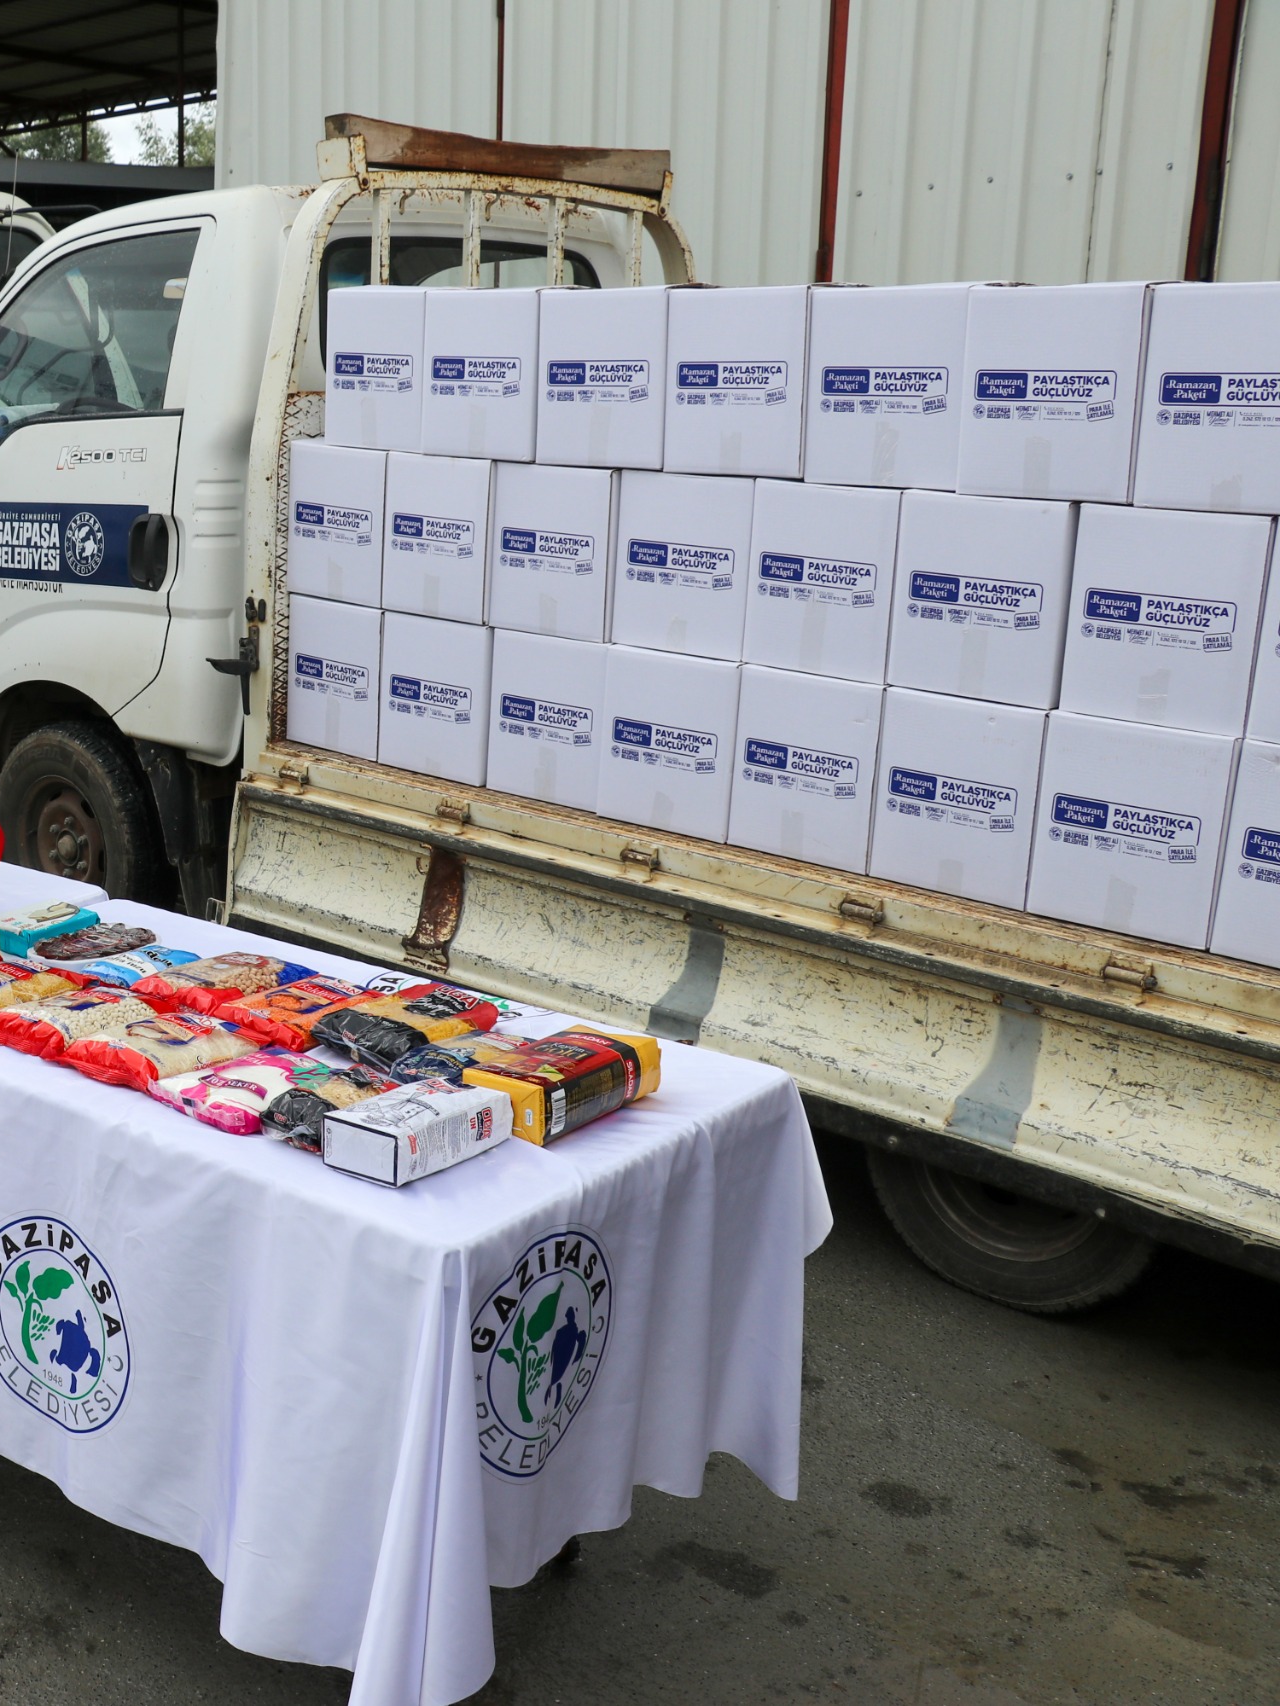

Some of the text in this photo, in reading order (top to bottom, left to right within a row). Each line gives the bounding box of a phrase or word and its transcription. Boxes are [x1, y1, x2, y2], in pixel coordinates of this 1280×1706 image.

[366, 357, 408, 366] PAYLAŞTIKÇA
[467, 360, 516, 370] PAYLAŞTIKÇA
[366, 364, 400, 375] GÜÇLÜYÜZ
[467, 368, 505, 379] GÜÇLÜYÜZ
[588, 364, 643, 374] PAYLAŞTIKÇA
[680, 367, 717, 377] Ramazan
[723, 365, 783, 376] PAYLAŞTIKÇA
[588, 372, 632, 384] GÜÇLÜYÜZ
[686, 375, 709, 385] Paketi
[722, 374, 770, 386] GÜÇLÜYÜZ
[826, 372, 867, 384] Ramazan
[874, 371, 942, 382] PAYLAŞTIKÇA
[980, 375, 1025, 388] Ramazan
[1033, 375, 1109, 387] PAYLAŞTIKÇA
[832, 381, 858, 391] Paketi
[873, 380, 928, 394] GÜÇLÜYÜZ
[986, 385, 1015, 396] Paketi
[1032, 384, 1093, 399] GÜÇLÜYÜZ
[1166, 379, 1218, 392] Ramazan
[1173, 389, 1206, 401] Paketi
[56, 445, 147, 470] K2500 TCI
[326, 508, 368, 521] PAYLAŞTIKÇA
[326, 515, 359, 528] GÜÇLÜYÜZ
[425, 519, 469, 532] PAYLAŞTIKÇA
[425, 527, 460, 540] GÜÇLÜYÜZ
[539, 534, 589, 548] PAYLAŞTIKÇA
[538, 542, 578, 556] GÜÇLÜYÜZ
[631, 544, 665, 557] Ramazan
[671, 547, 729, 562] PAYLAŞTIKÇA
[636, 553, 658, 563] Paketi
[671, 555, 716, 570] GÜÇLÜYÜZ
[763, 557, 802, 572] Ramazan
[769, 566, 793, 578] Paketi
[808, 561, 871, 578] PAYLAŞTIKÇA
[807, 570, 858, 587] GÜÇLÜYÜZ
[914, 576, 957, 592] Ramazan
[920, 587, 947, 598] Paketi
[964, 581, 1036, 598] PAYLAŞTIKÇA
[963, 591, 1021, 608] GÜÇLÜYÜZ
[1090, 594, 1138, 611] Ramazan
[1096, 605, 1127, 617] Paketi
[1147, 599, 1229, 618] PAYLAŞTIKÇA
[1145, 609, 1211, 628] GÜÇLÜYÜZ
[324, 662, 363, 678] PAYLAŞTIKÇA
[324, 670, 355, 685] GÜÇLÜYÜZ
[424, 684, 468, 700] PAYLAŞTIKÇA
[423, 692, 458, 707] GÜÇLÜYÜZ
[538, 703, 587, 720] PAYLAŞTIKÇA
[537, 712, 577, 727] GÜÇLÜYÜZ
[616, 722, 649, 738] Ramazan
[621, 731, 642, 742] Paketi
[655, 728, 711, 746] PAYLAŞTIKÇA
[654, 737, 699, 754] GÜÇLÜYÜZ
[749, 743, 785, 760] Ramazan
[754, 753, 777, 764] Paketi
[791, 750, 852, 770] PAYLAŞTIKÇA
[790, 759, 839, 778] GÜÇLÜYÜZ
[893, 772, 934, 791] Ramazan
[899, 783, 925, 795] Paketi
[941, 780, 1011, 802] PAYLAŞTIKÇA
[940, 790, 996, 810] GÜÇLÜYÜZ
[1058, 799, 1105, 819] Ramazan
[1064, 810, 1094, 823] Paketi
[1113, 808, 1193, 831] PAYLAŞTIKÇA
[1112, 818, 1176, 840] GÜÇLÜYÜZ
[42, 1369, 63, 1386] 1948
[537, 1413, 550, 1431] 194
